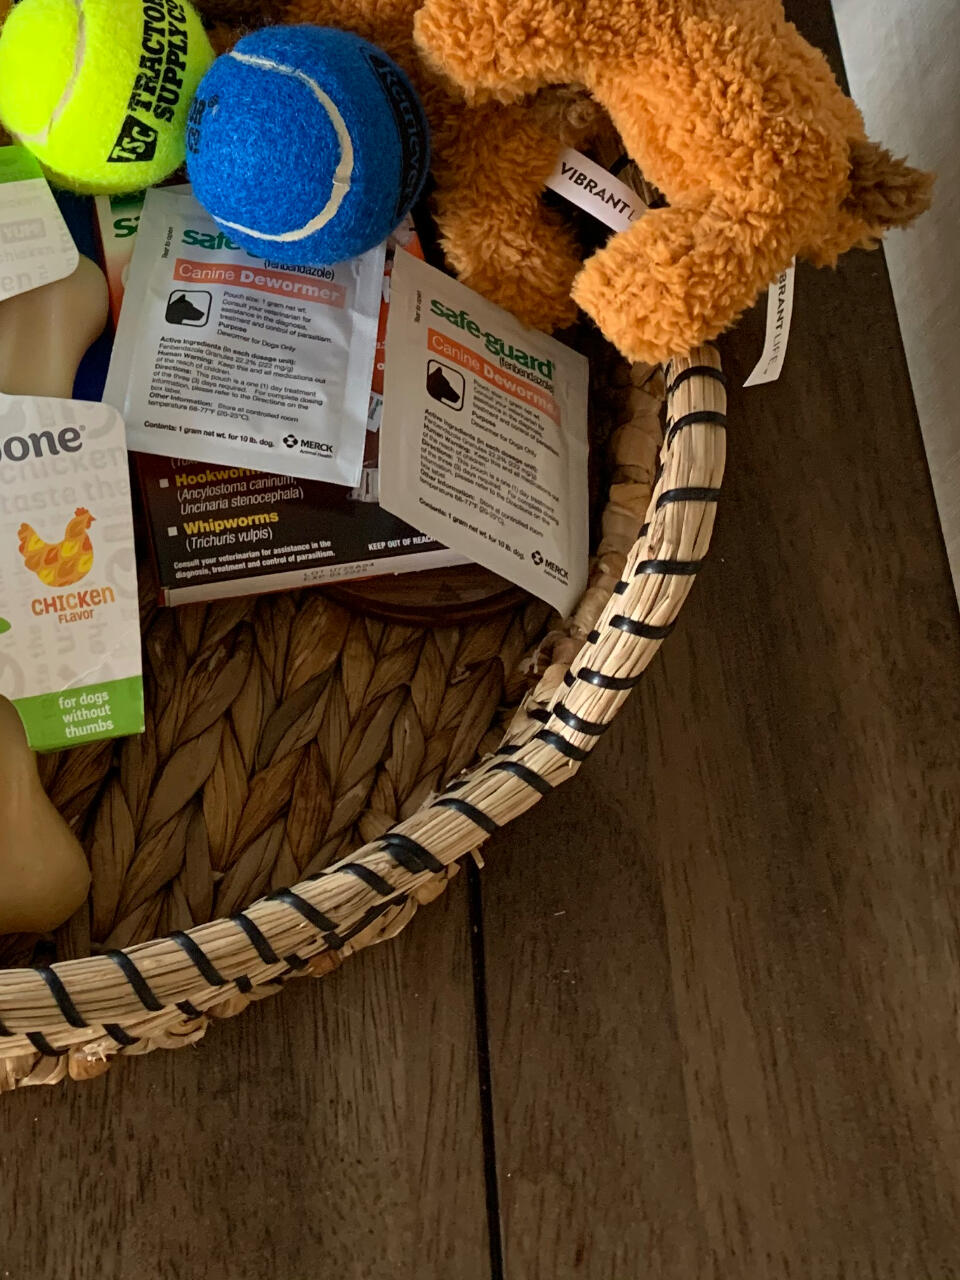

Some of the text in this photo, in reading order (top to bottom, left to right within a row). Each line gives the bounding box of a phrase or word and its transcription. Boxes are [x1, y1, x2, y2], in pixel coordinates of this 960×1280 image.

[153, 21, 188, 122] SUPPLY
[111, 126, 156, 160] TSC
[560, 161, 630, 216] VIBRANT
[178, 262, 342, 301] Canine Dewormer
[777, 273, 788, 331] BRANT
[217, 321, 247, 333] Purpose
[215, 329, 249, 341] Dewormer
[260, 339, 279, 349] Dogs
[280, 343, 296, 352] Only
[430, 299, 553, 381] safe-guard
[432, 335, 480, 371] Canine
[483, 365, 558, 413] Deworme
[300, 439, 333, 453] MERCK
[175, 467, 264, 486] Hookwor
[178, 482, 247, 502] (Ancylostoma
[181, 487, 304, 515] Uncinaria stenocephala)
[183, 510, 279, 535] Whipworms
[186, 525, 273, 551] (Trichuris vulpis)
[368, 542, 385, 551] KEEP
[388, 540, 400, 548] OUT
[173, 558, 199, 569] Consult
[200, 557, 217, 565] your
[218, 550, 260, 562] veterinarian
[261, 548, 271, 556] for
[272, 542, 310, 554] assistance
[319, 539, 331, 547] the
[175, 548, 335, 579] diagnosis, treatment and control of parasitism.
[545, 560, 569, 580] MERCK
[59, 691, 109, 709] for dogs
[62, 704, 111, 723] without
[66, 720, 114, 738] thumbs
